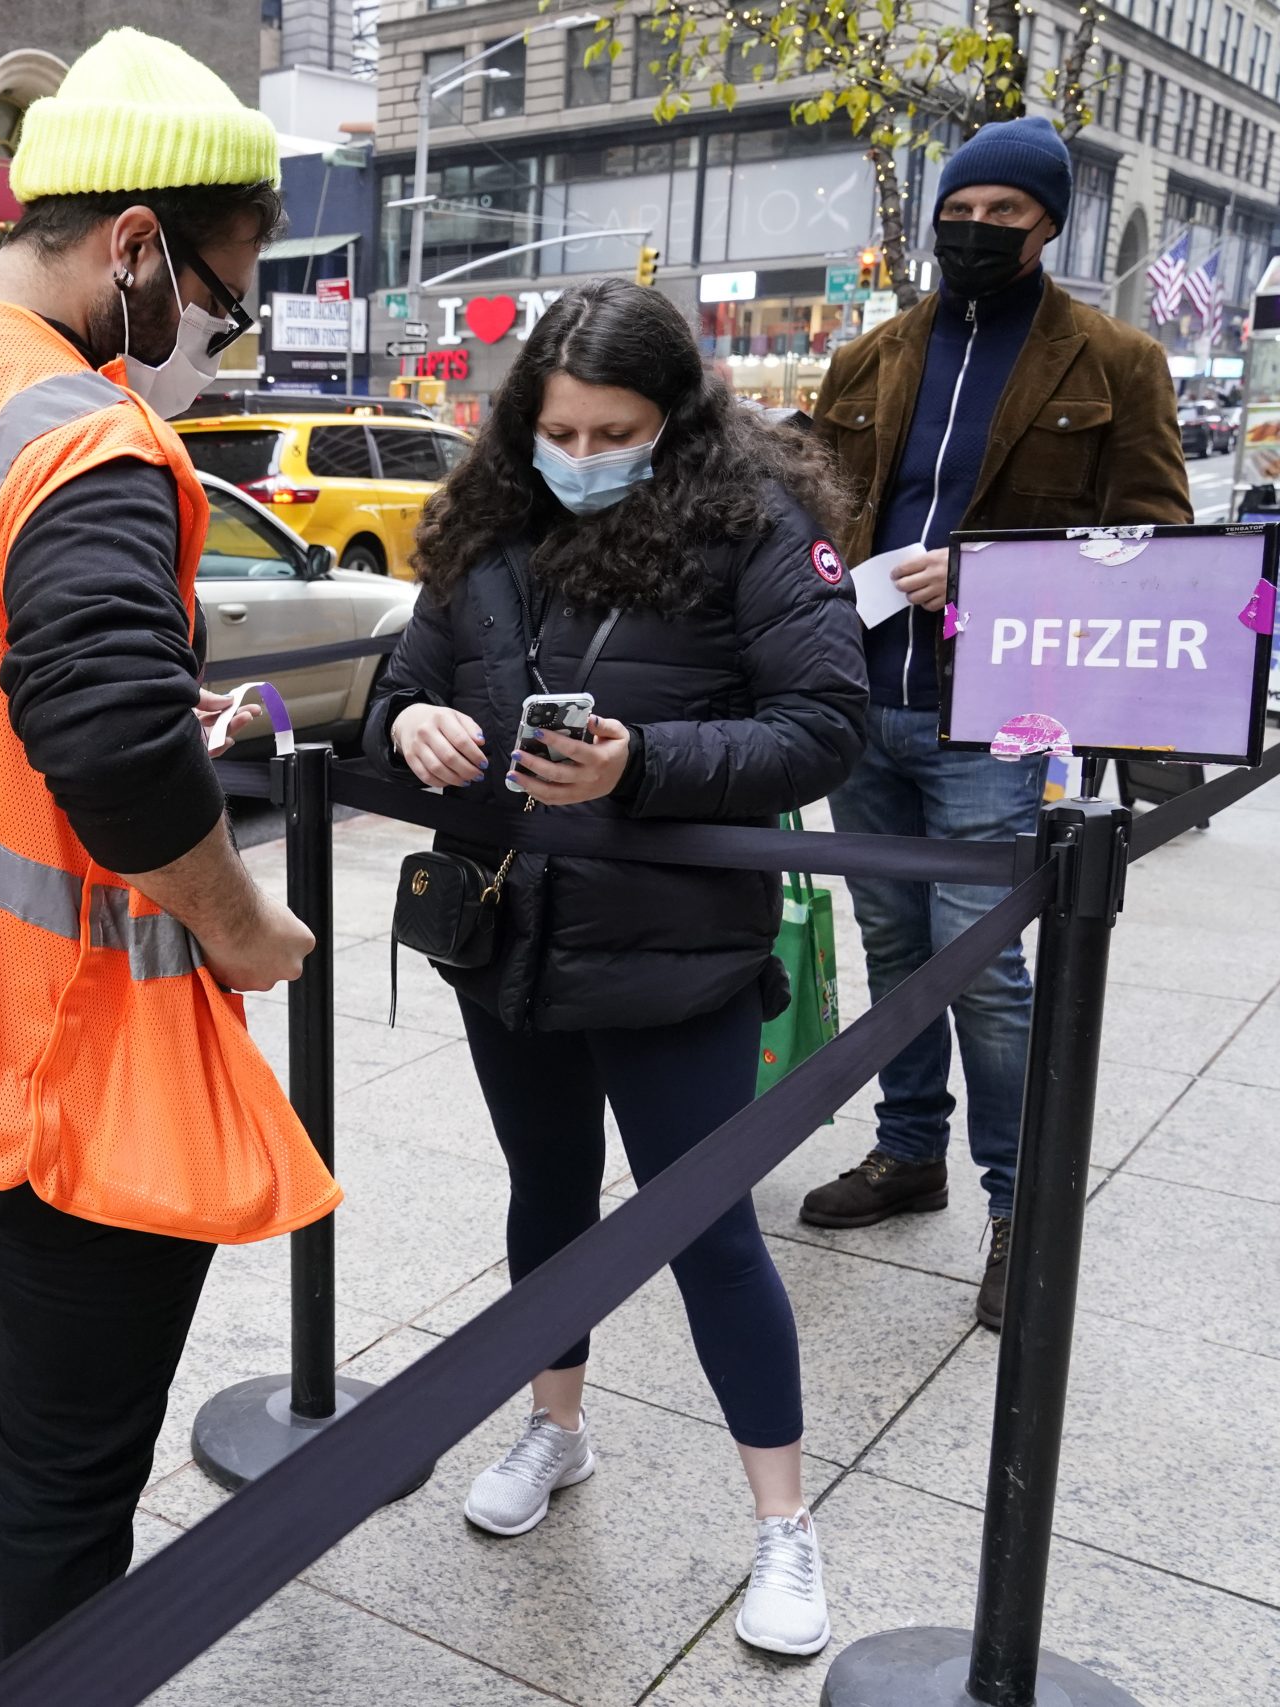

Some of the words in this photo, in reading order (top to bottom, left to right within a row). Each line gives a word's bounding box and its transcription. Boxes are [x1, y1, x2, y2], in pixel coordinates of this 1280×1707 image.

[285, 299, 312, 319] HUGH
[313, 301, 352, 321] JACKMA
[436, 297, 464, 346] I
[322, 327, 352, 349] FOSTE
[400, 349, 469, 381] IFTS
[990, 617, 1209, 670] PFIZER
